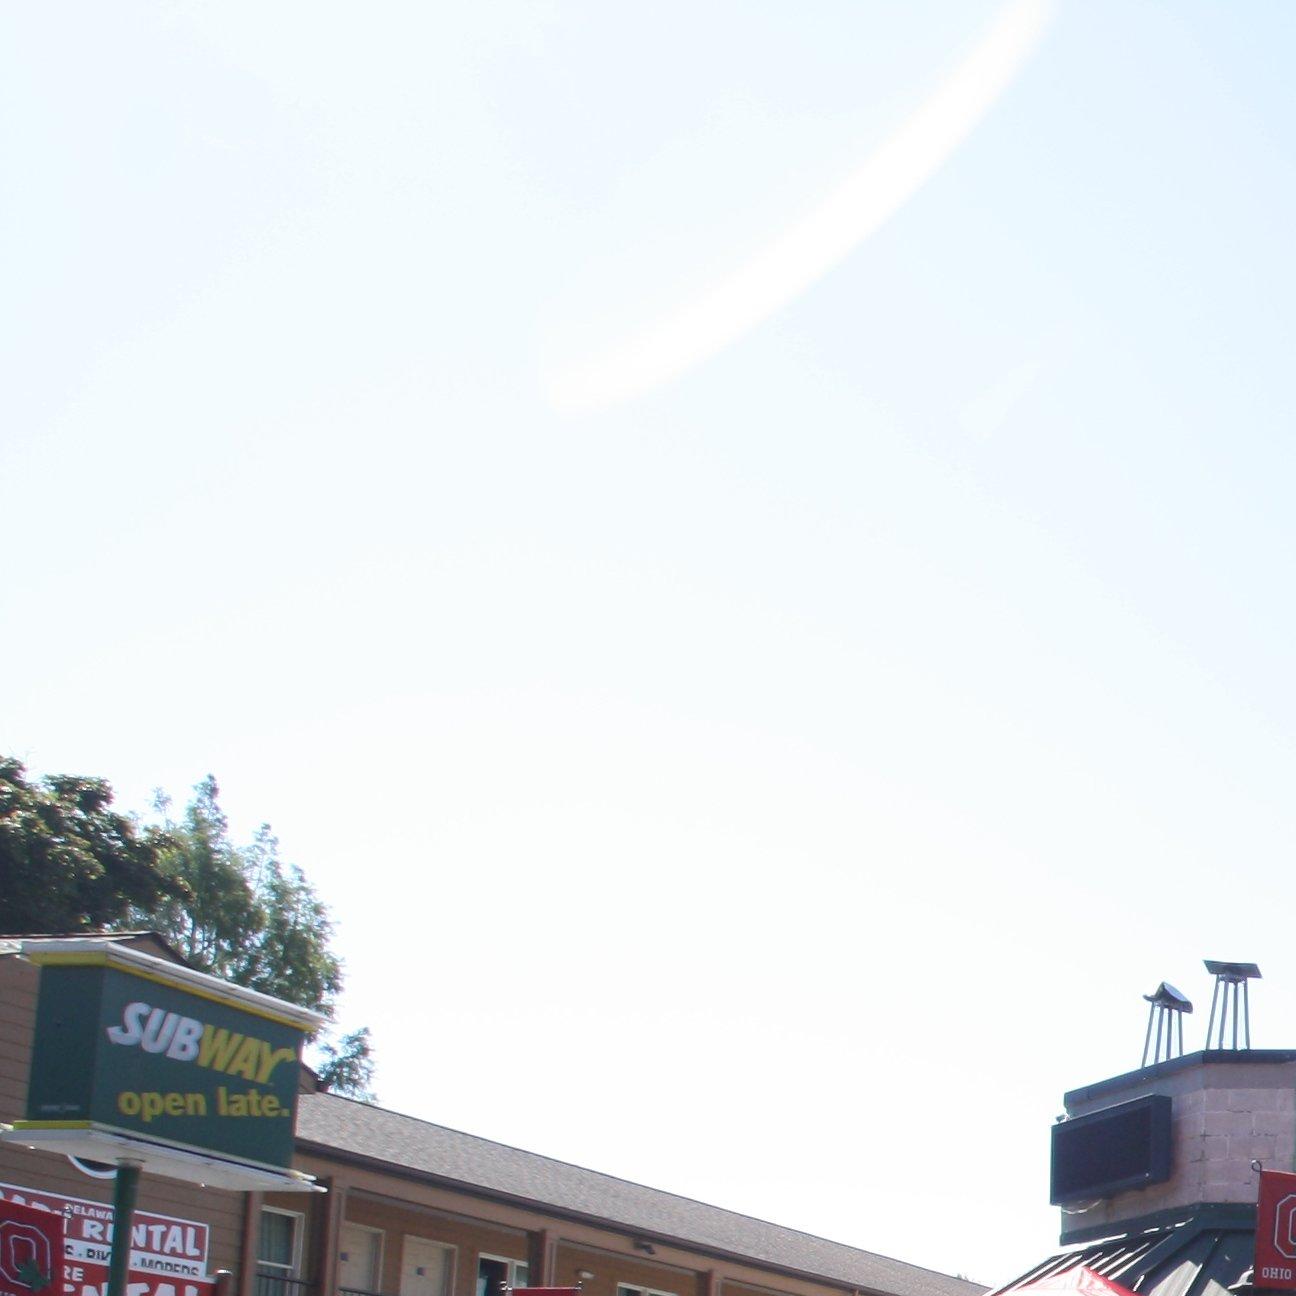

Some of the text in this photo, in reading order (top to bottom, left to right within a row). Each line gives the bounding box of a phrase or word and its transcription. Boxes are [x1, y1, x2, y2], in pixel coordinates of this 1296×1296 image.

[107, 1002, 296, 1084] SUBWAY
[117, 1086, 290, 1122] open late.
[1262, 1267, 1292, 1280] OHIO
